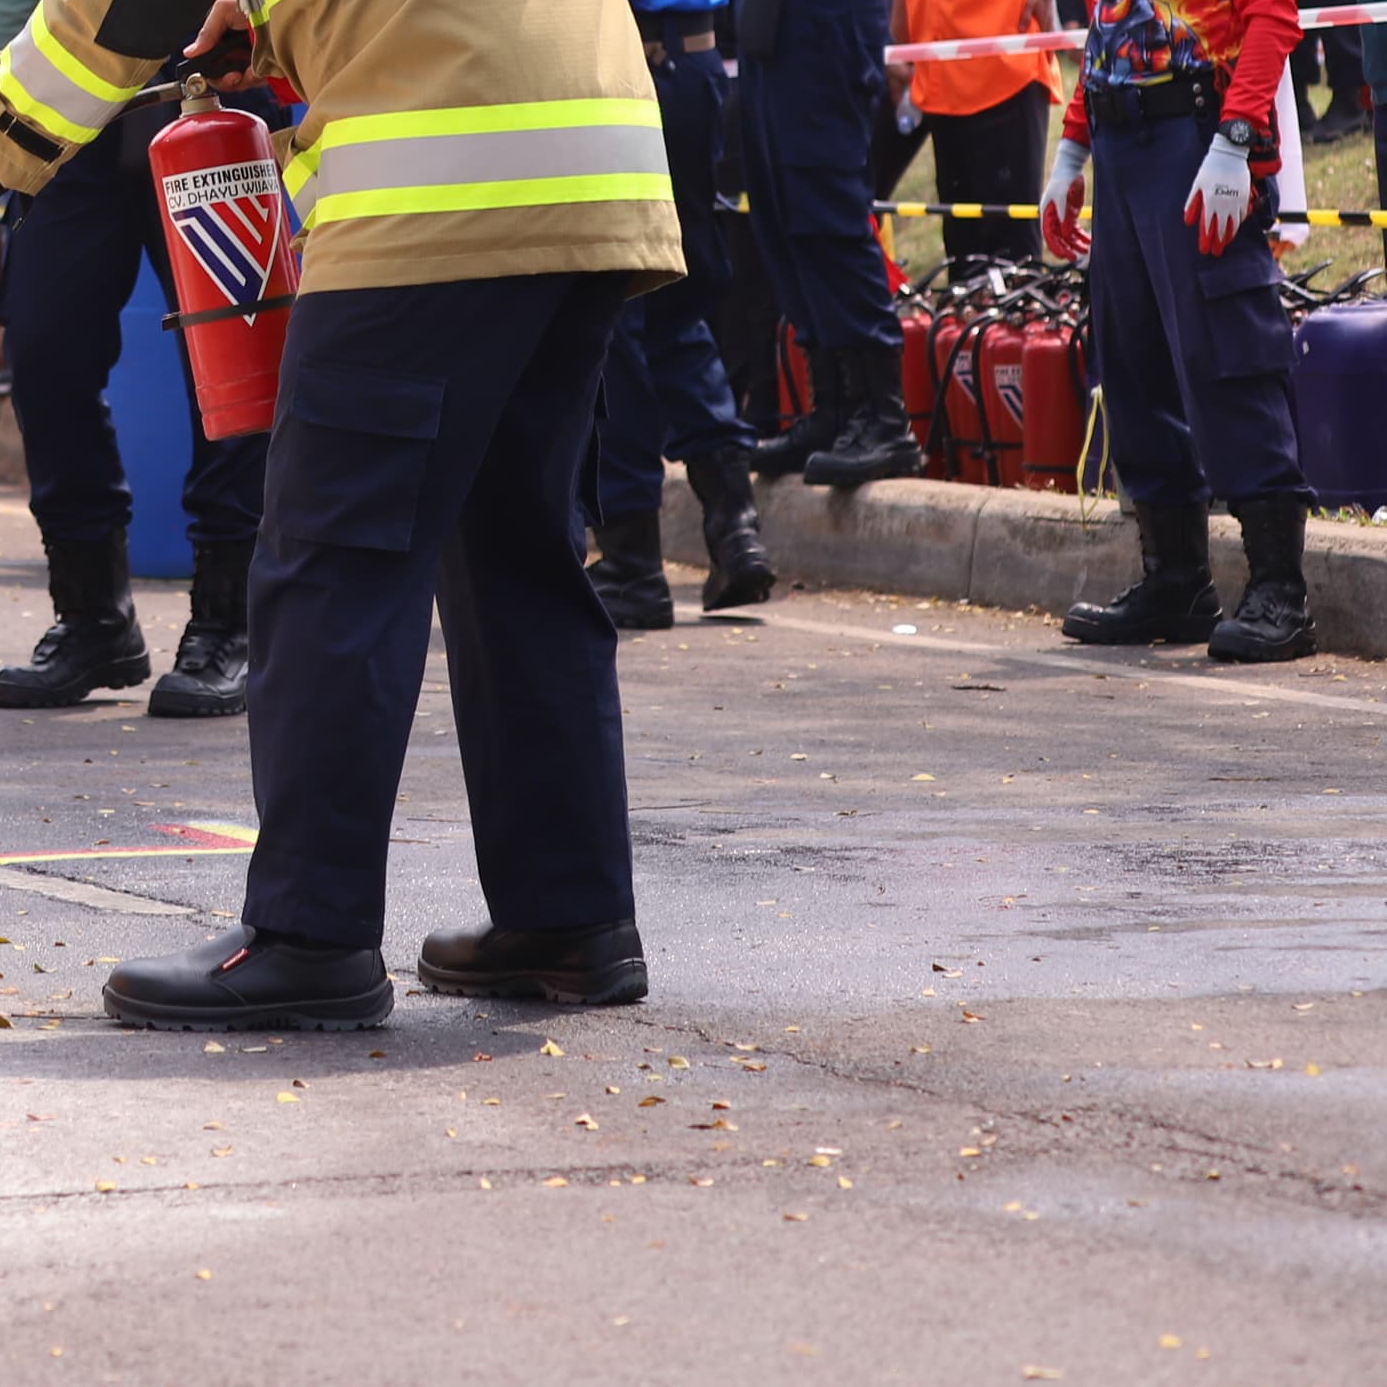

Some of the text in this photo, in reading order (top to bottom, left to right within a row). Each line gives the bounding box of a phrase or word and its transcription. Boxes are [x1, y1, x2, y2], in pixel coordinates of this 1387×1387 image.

[165, 178, 189, 195] FIRE
[169, 196, 186, 209] CV.
[188, 185, 239, 204] DHAYU
